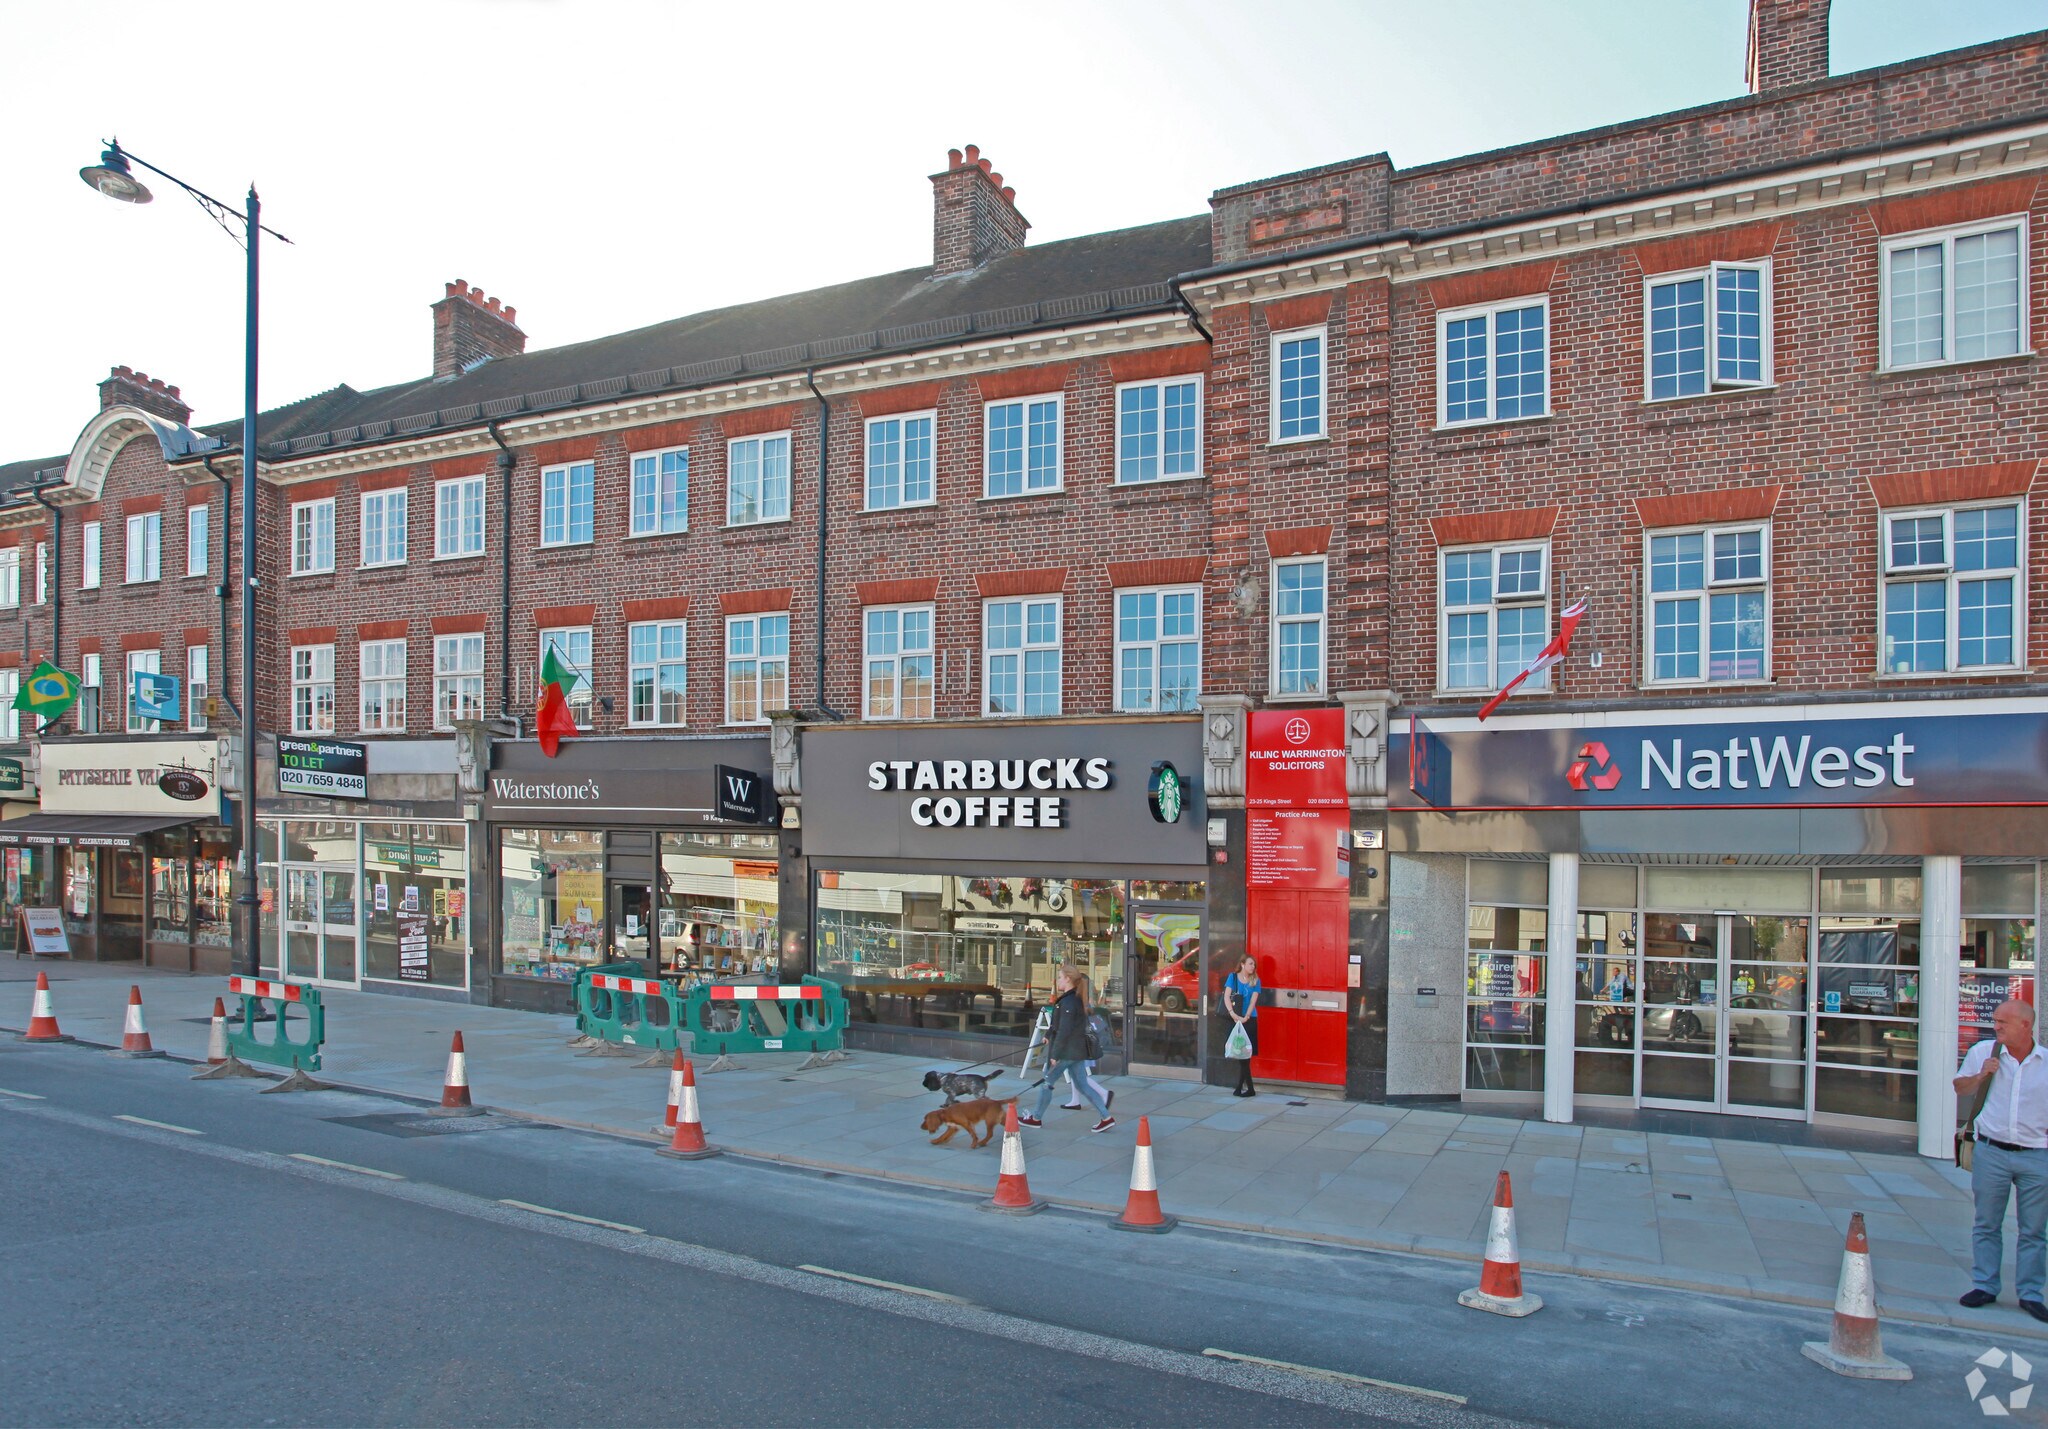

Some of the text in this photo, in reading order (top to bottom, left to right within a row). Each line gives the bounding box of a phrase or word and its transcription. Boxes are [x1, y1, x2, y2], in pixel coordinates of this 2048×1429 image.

[280, 740, 363, 757] green&partners
[1250, 749, 1346, 759] KILINC WARRINGTON
[282, 754, 325, 769] TO LET
[1269, 761, 1325, 770] SOLICITORS
[1641, 732, 1914, 790] NatWest
[58, 768, 133, 786] PATISSERIE
[281, 771, 363, 790] 020 7659 4848
[868, 757, 1111, 791] STARBUCKS
[492, 778, 600, 800] Waterstone's
[726, 775, 752, 802] W
[723, 800, 756, 815] Waterstone's
[910, 796, 1061, 827] COFFEE
